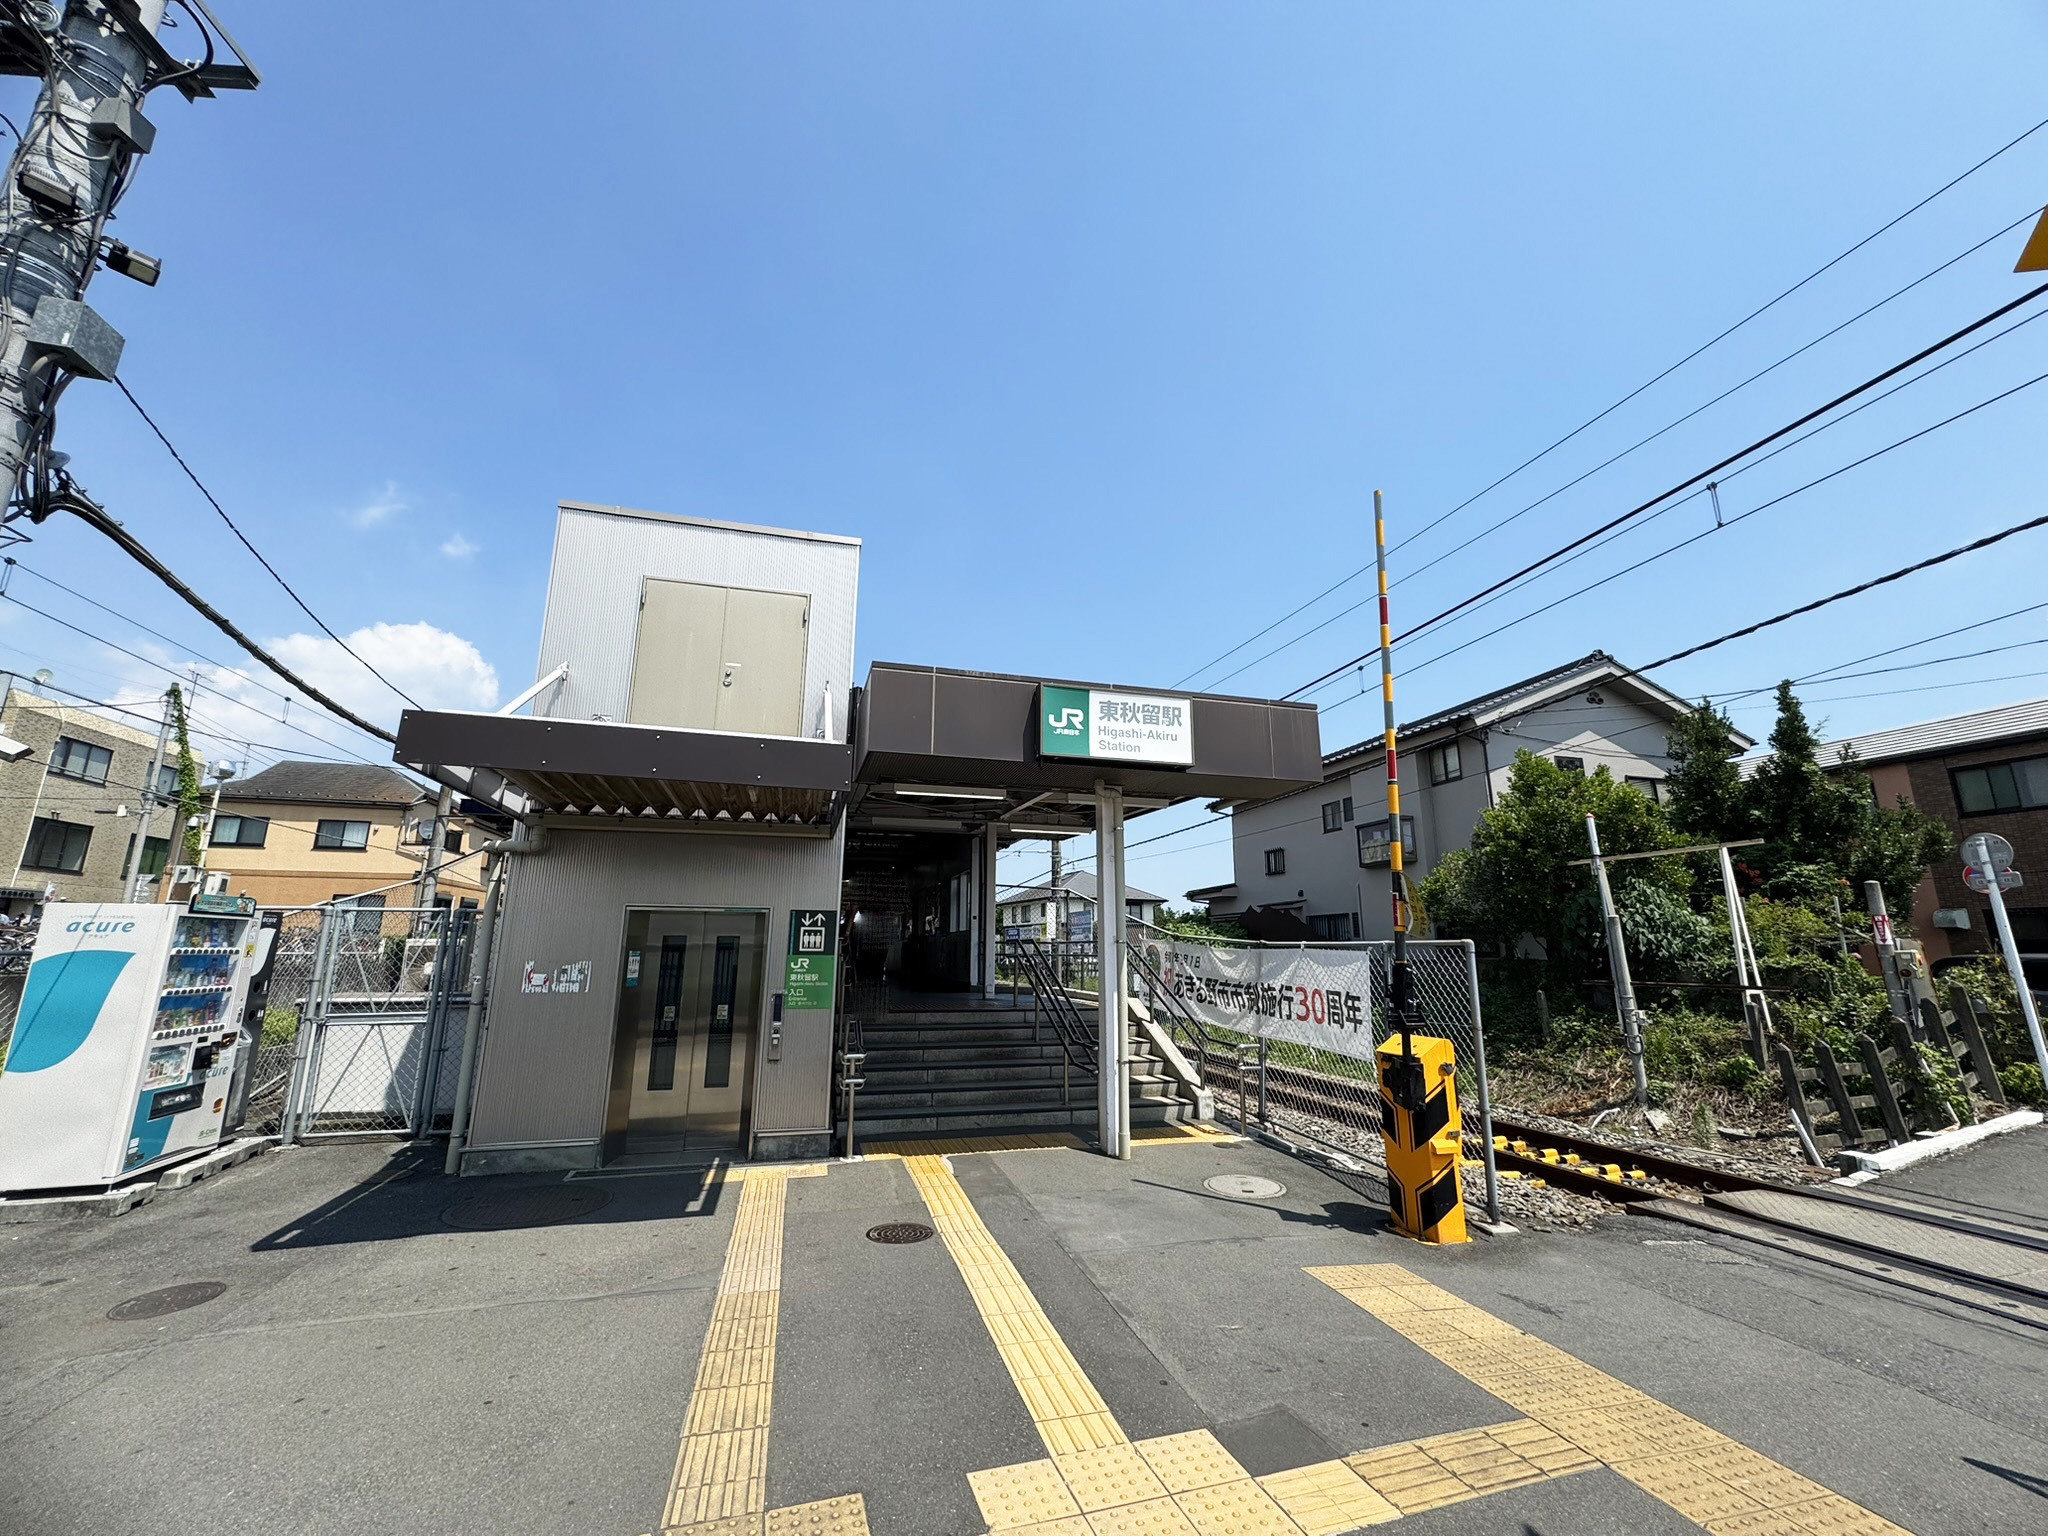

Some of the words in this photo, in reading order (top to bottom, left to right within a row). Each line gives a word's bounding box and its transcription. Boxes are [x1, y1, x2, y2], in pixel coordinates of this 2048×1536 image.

[1048, 708, 1084, 730] JR
[1098, 700, 1182, 727] 東秋留駅
[1098, 725, 1178, 742] Higashi-Akiru
[1098, 740, 1141, 753] Station
[66, 921, 136, 933] acure
[790, 958, 810, 969] JR
[789, 973, 819, 982] 東秋留駅
[788, 988, 804, 996] 入口
[1173, 971, 1363, 1033] あきる野市市制施行30周年
[199, 1065, 229, 1080] acure
